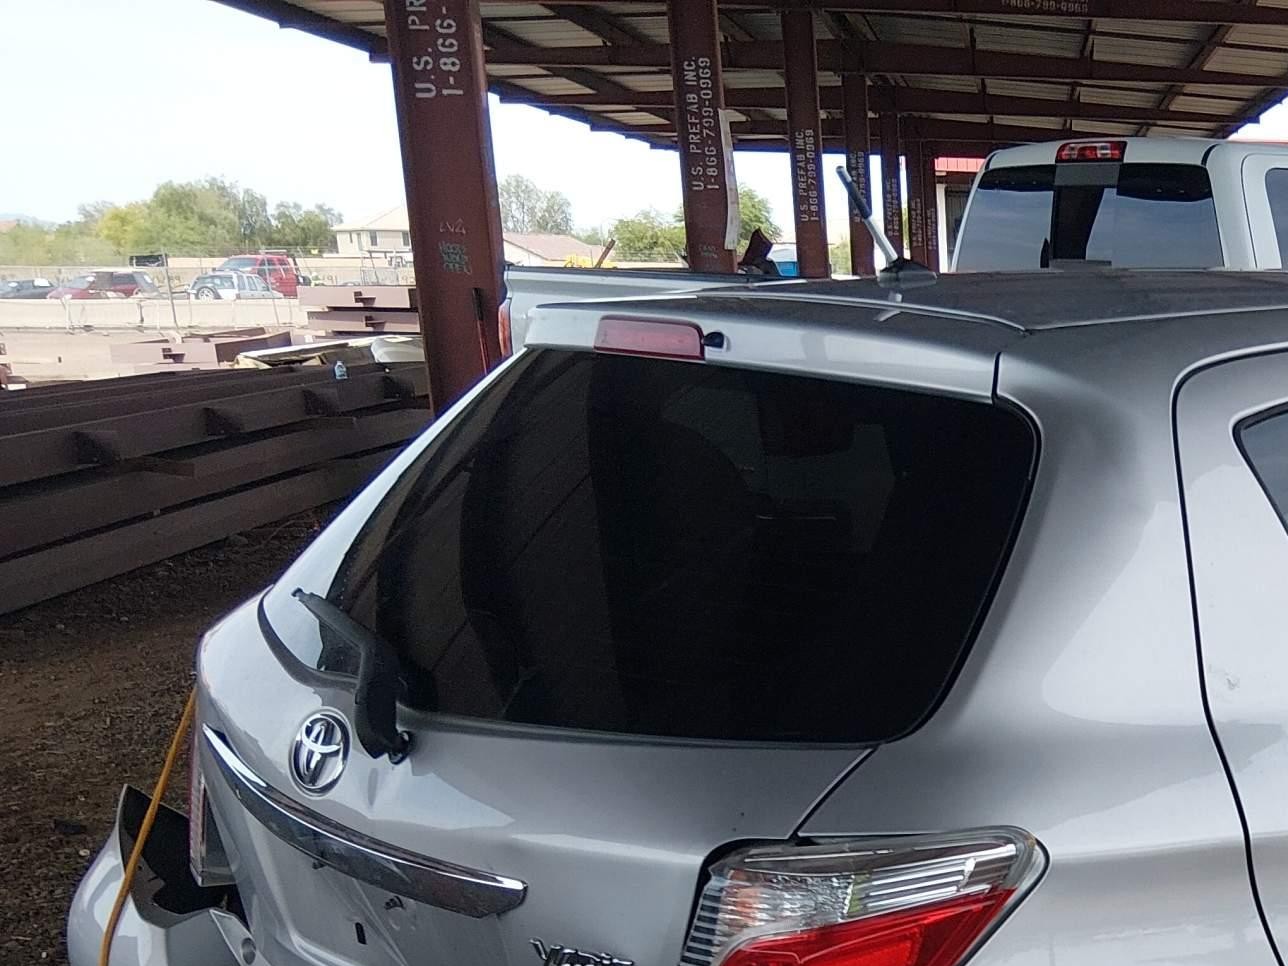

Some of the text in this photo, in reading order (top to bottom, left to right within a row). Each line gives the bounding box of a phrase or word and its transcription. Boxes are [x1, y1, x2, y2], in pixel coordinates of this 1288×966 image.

[412, 47, 438, 98] U.S.
[683, 56, 705, 191] U.S. PREFAB INC.
[698, 57, 720, 190] 1-866-799-0969
[796, 154, 808, 196] PREFAB
